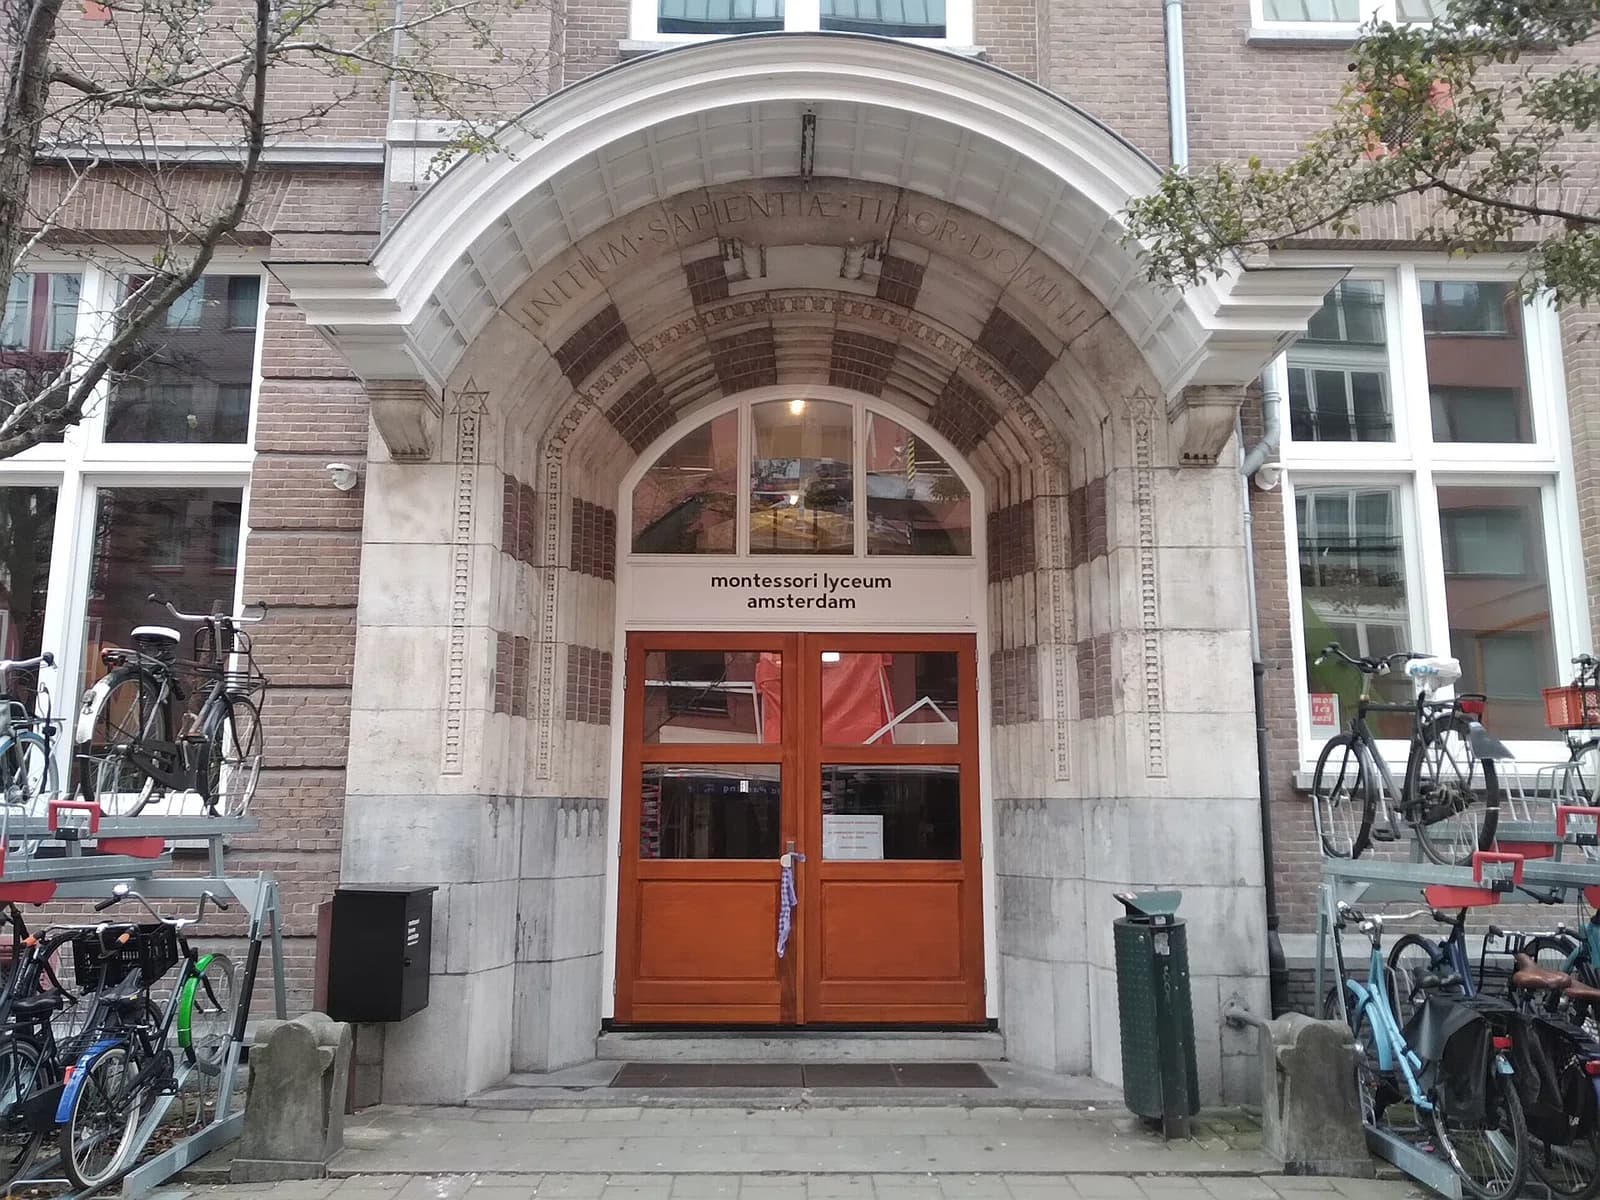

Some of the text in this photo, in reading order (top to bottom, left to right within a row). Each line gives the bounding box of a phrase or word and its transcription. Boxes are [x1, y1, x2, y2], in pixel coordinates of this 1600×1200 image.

[711, 573, 892, 593] montessori lyceum
[747, 593, 856, 609] amsterdam
